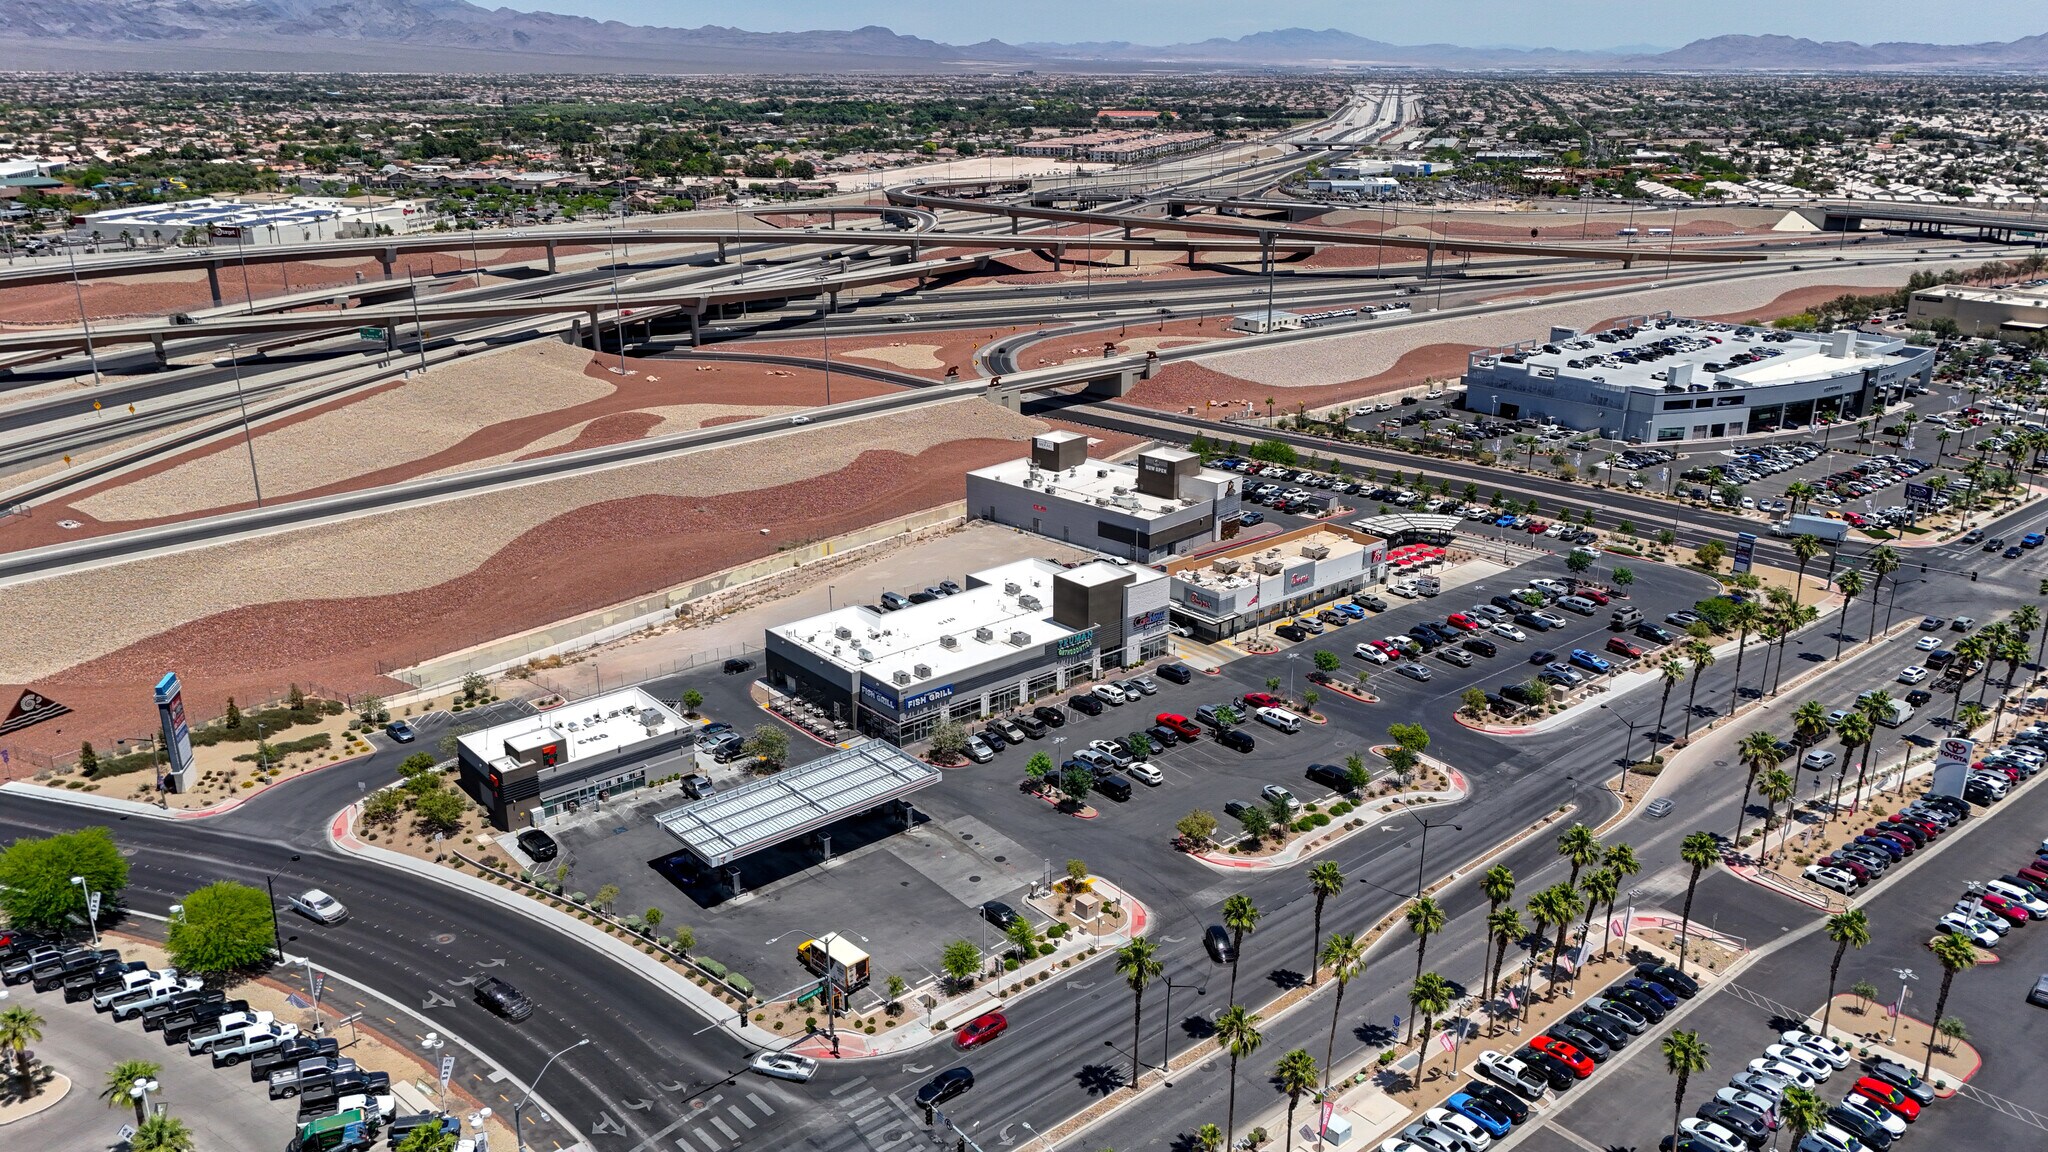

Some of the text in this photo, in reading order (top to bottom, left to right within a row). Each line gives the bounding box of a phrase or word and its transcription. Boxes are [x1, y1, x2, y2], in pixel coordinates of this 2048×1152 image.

[1145, 464, 1167, 475] NOW OPEN
[1058, 630, 1093, 648] TRUMAN
[861, 685, 895, 709] FISH GRILL
[907, 696, 926, 709] FISH
[928, 687, 953, 701] GRILL
[1940, 749, 1968, 763] TOYOTA
